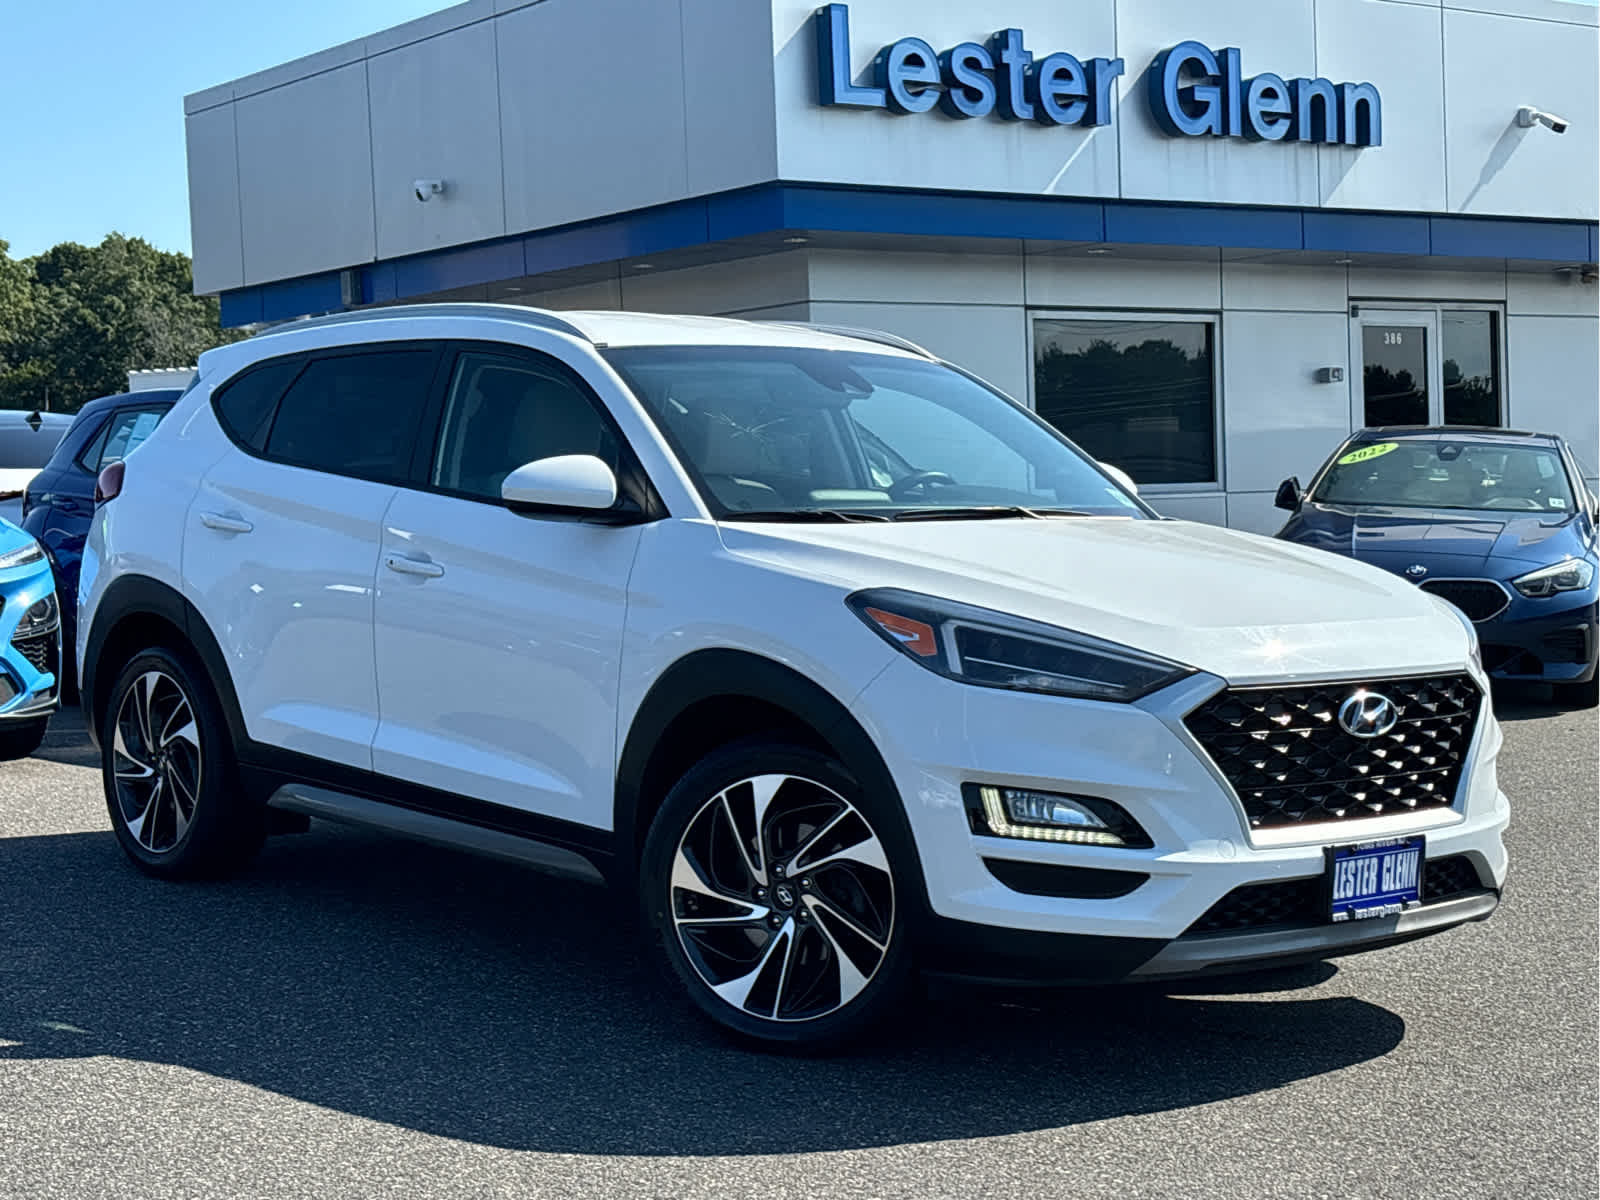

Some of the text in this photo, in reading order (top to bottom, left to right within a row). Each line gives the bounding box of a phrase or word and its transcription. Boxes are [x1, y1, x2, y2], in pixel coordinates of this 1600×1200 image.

[817, 3, 1382, 147] Lester Glenn
[1384, 332, 1402, 345] 386
[1351, 443, 1387, 462] 2022
[1333, 850, 1419, 900] LESTER GLENN
